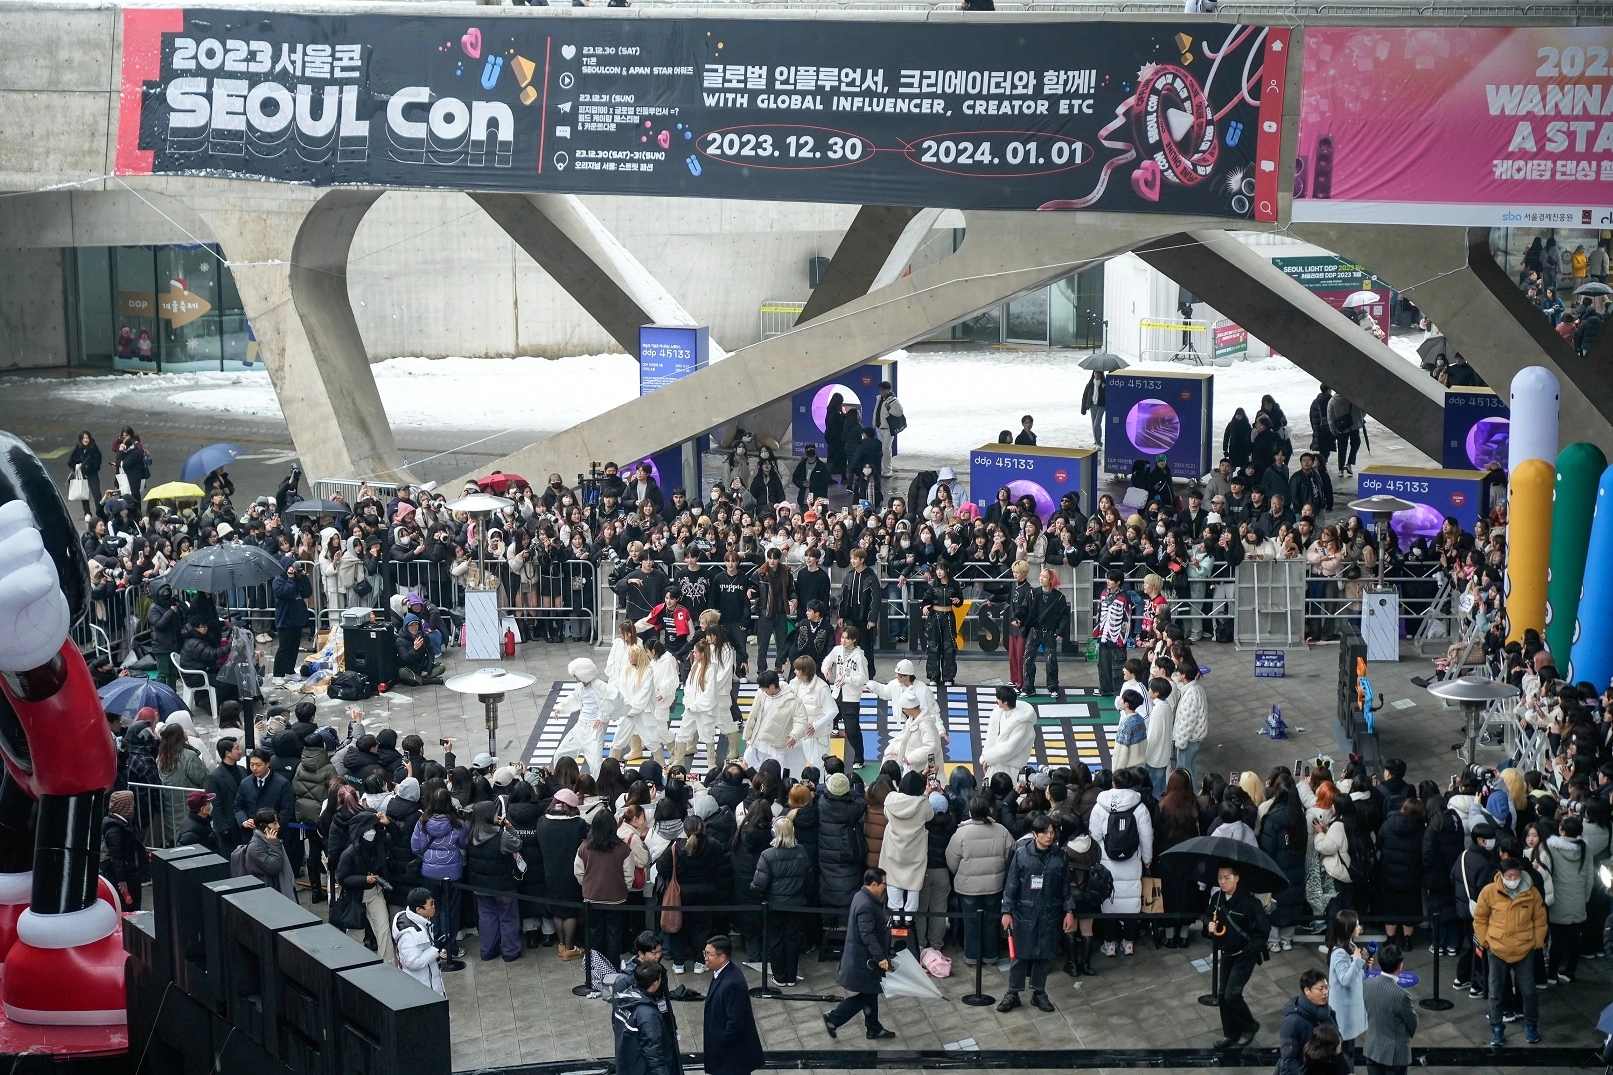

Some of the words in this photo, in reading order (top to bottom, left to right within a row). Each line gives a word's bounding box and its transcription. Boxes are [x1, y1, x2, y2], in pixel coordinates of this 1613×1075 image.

[582, 46, 616, 55] 23.12.30
[618, 46, 640, 56] (SAT)
[173, 38, 272, 71] 2023
[275, 43, 362, 78] 서울콘
[1536, 46, 1613, 77] 202
[581, 66, 621, 75] SEOULCON
[622, 67, 627, 75] &
[628, 66, 651, 75] APAN
[653, 66, 673, 75] STAR
[673, 66, 694, 75] 어워즈
[703, 64, 768, 89] 글로벌
[774, 65, 889, 93] 인플루언서,
[898, 69, 1037, 95] 크리에이터와
[1043, 69, 1097, 95] 함께!
[579, 94, 610, 102] 23.12.31
[611, 94, 635, 103] (SUN)
[703, 92, 748, 108] WITH
[756, 93, 824, 110] GLOBAL
[832, 96, 952, 116] INFLUENCER,
[962, 99, 1049, 115] CREATOR
[1058, 99, 1094, 114] ETC
[166, 77, 370, 138] SEOUL
[386, 86, 515, 142] Con
[614, 106, 635, 115] 글로벌
[636, 107, 669, 116] 인플루언서
[592, 115, 613, 123] 케이팝
[613, 116, 640, 124] 페스티벌
[577, 123, 583, 131] &
[583, 123, 617, 131] 카운트다운
[1508, 121, 1537, 153] A
[706, 132, 780, 157] 2023.
[786, 135, 821, 159] 12.
[827, 136, 863, 160] 30
[921, 140, 1000, 165] 2024.
[1006, 141, 1045, 165] 01.
[1051, 141, 1083, 165] 01
[575, 161, 601, 171] 오리지널
[618, 163, 639, 172] 스트릿
[639, 163, 654, 172] 패션
[1492, 159, 1554, 180] 케이팝
[1555, 160, 1597, 181] 댄싱
[1524, 212, 1574, 223] 서울경제진흥원
[642, 349, 657, 358] ddp
[659, 349, 691, 359] 45133
[1109, 379, 1125, 388] ddp
[1127, 379, 1162, 390] 45133
[1448, 397, 1466, 406] ddp
[974, 455, 992, 467] ddp
[995, 456, 1034, 470] 45133
[1363, 479, 1383, 491] ddp
[1386, 480, 1429, 493] 45133
